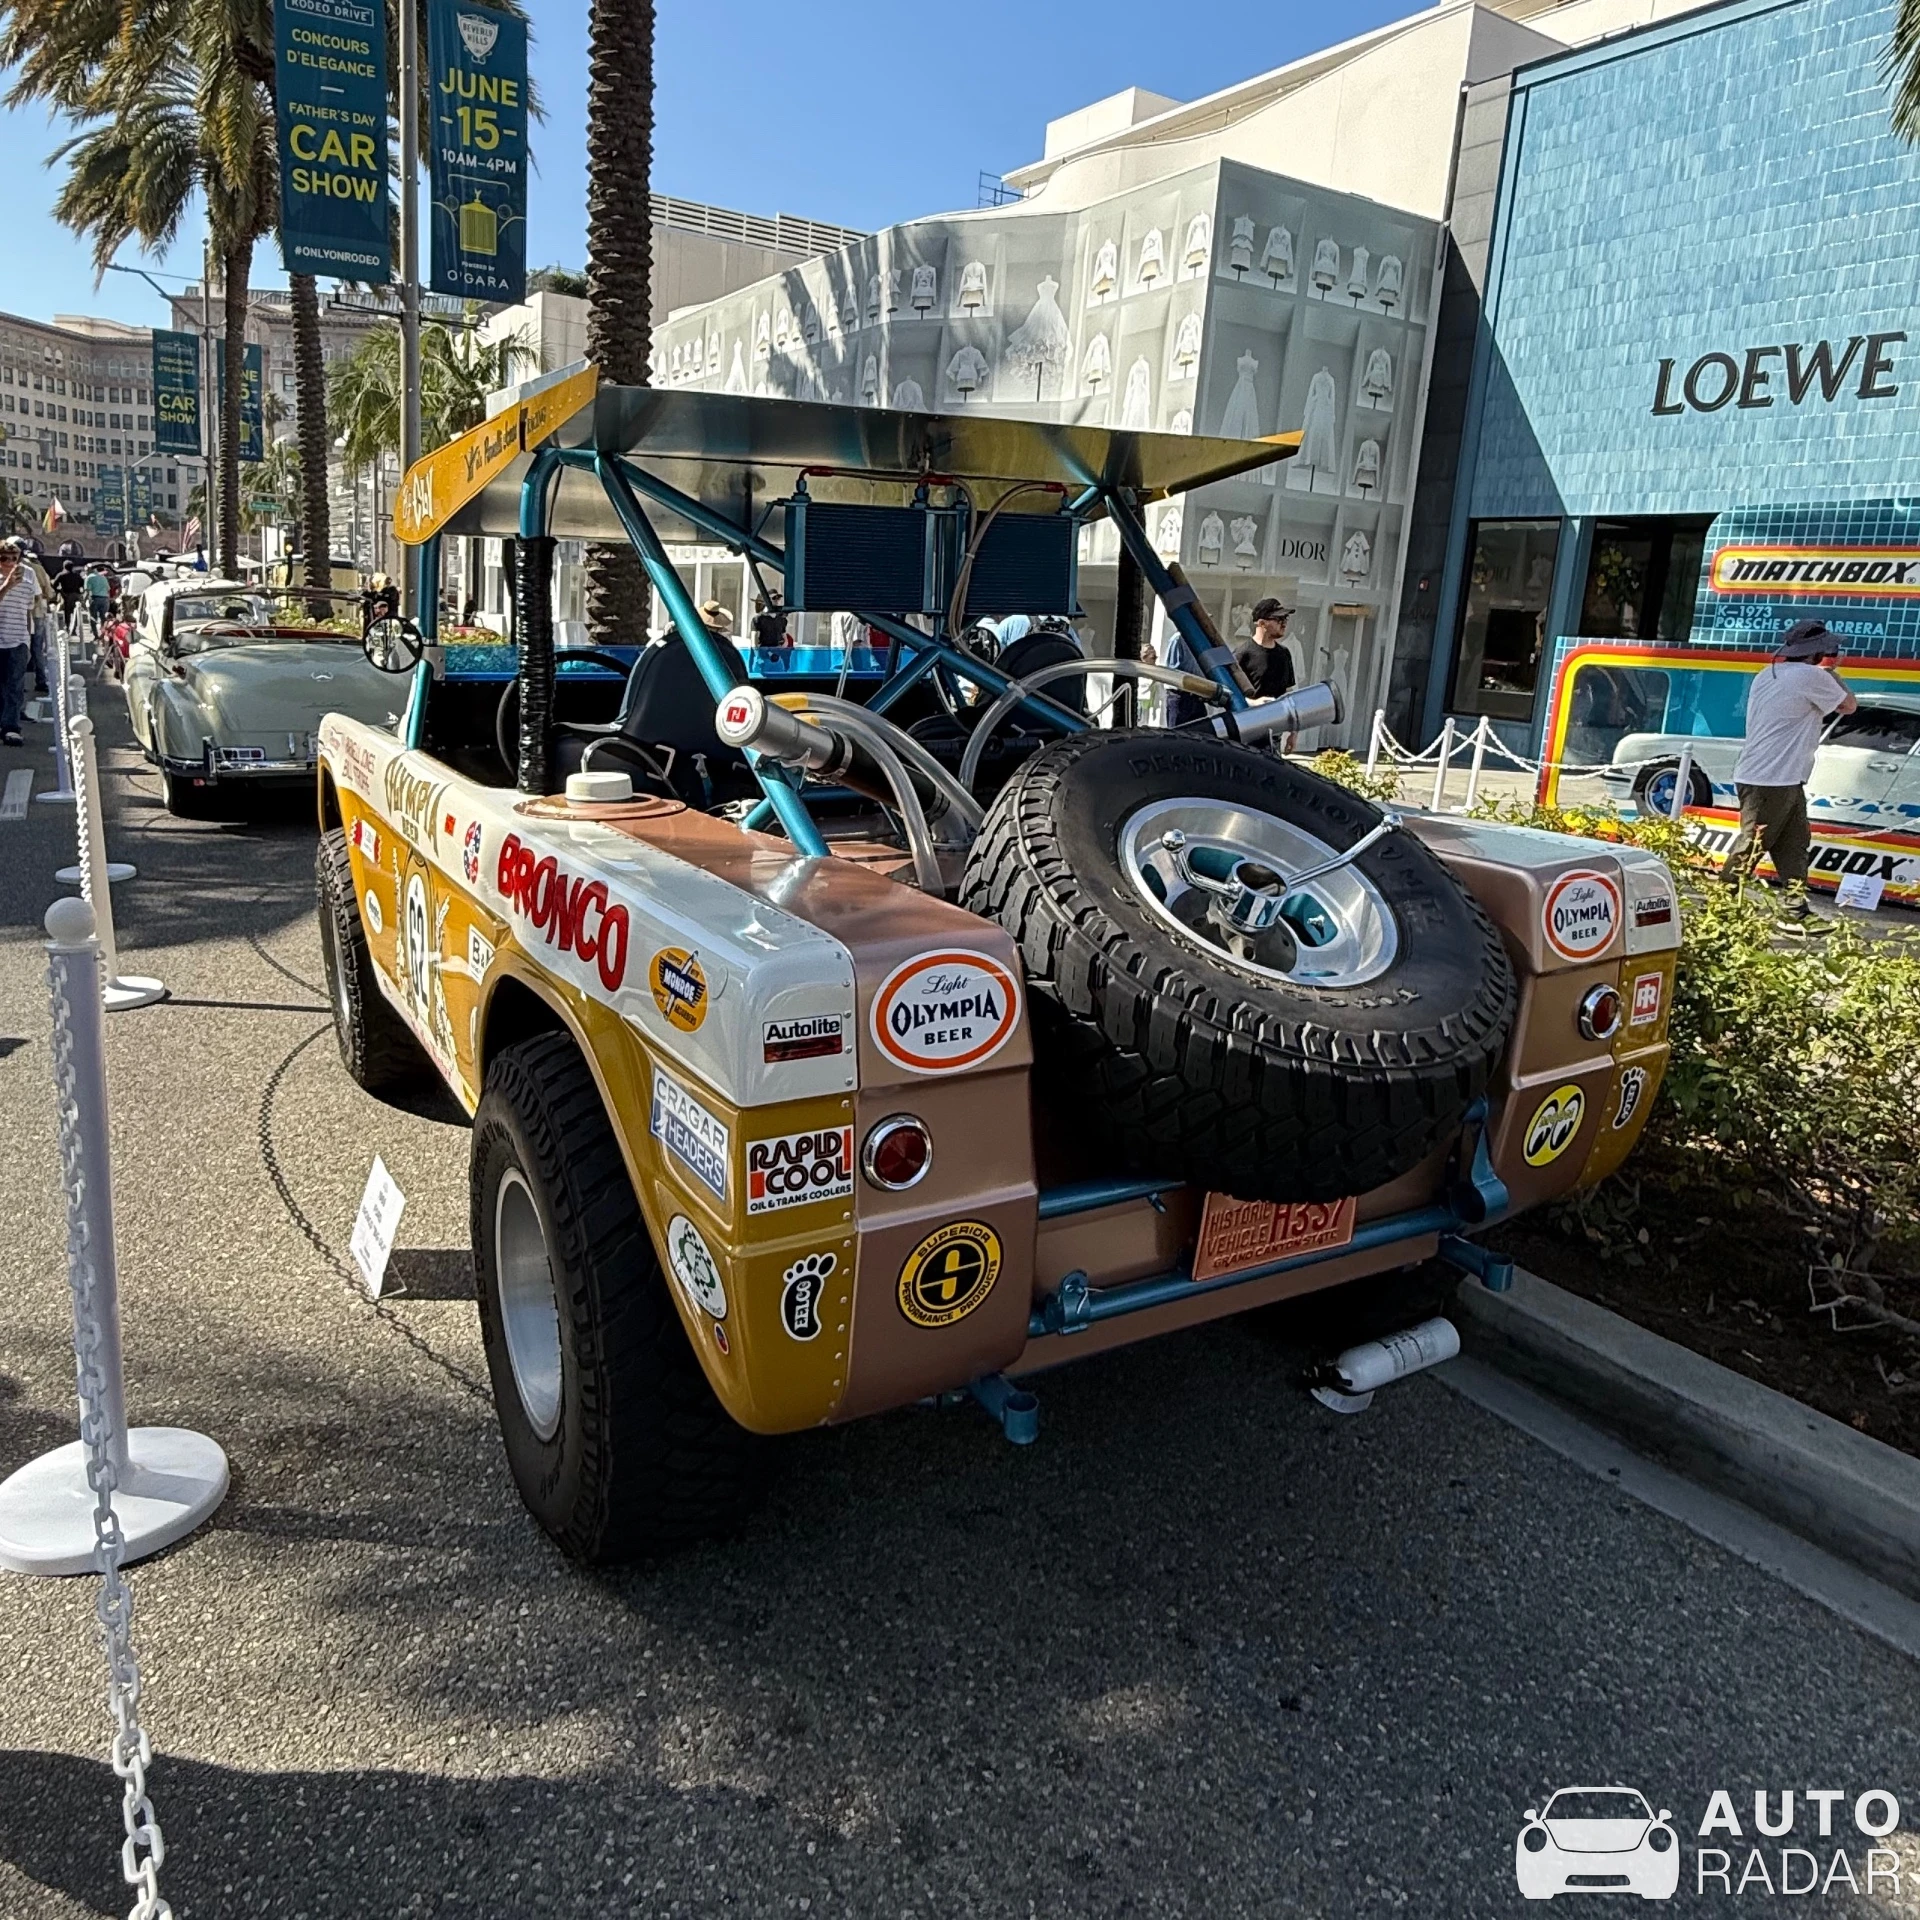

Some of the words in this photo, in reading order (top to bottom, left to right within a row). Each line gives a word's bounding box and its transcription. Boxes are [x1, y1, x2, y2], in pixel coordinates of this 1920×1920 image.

[334, 6, 368, 21] DRIVE
[291, 28, 370, 55] CONCOURS
[463, 23, 493, 37] BEVERLY
[467, 34, 488, 46] HILLS
[287, 49, 376, 78] D'ELEGANCE
[439, 68, 518, 107] JUNE
[289, 102, 350, 123] FATHER'S
[353, 113, 376, 128] DAY
[289, 125, 377, 171] CAR
[292, 168, 378, 203] SHOW
[295, 246, 380, 266] #ONLYONRODEO
[447, 269, 510, 290] O'GARA
[1650, 331, 1908, 416] LOEWE
[158, 393, 196, 412] CAR
[159, 410, 196, 425] SHOW
[1281, 539, 1326, 562] DIOR
[1729, 558, 1920, 584] MATCHBOX
[1717, 604, 1773, 618] K-1973
[1714, 616, 1781, 630] PORSCHE
[1824, 619, 1885, 636] ARRERA
[384, 753, 453, 859] OLYMPIA
[1568, 887, 1596, 903] Light
[1636, 898, 1671, 913] Autolite
[497, 832, 630, 993] BRONCO
[1553, 897, 1612, 933] OLYMPIA
[1571, 926, 1598, 941] BEER
[663, 967, 696, 1003] MONROE
[921, 974, 970, 995] Light
[890, 988, 1001, 1037] OLYMPIA
[765, 1017, 841, 1041] Autolite
[924, 1027, 973, 1046] BEER
[656, 1077, 725, 1155] CRAGAR
[667, 1115, 724, 1188] HEADERS
[750, 1130, 843, 1172] RAPID
[766, 1157, 852, 1195] COOL
[750, 1202, 767, 1212] OIL
[768, 1199, 776, 1208] &
[776, 1193, 808, 1207] TRANS
[809, 1184, 852, 1199] COOLERS
[1209, 1201, 1272, 1233] HISTORIC
[917, 1225, 991, 1258] SUPERIOR
[1207, 1223, 1269, 1257] VEHICLE
[1213, 1250, 1252, 1268] GRAND
[1255, 1237, 1301, 1258] CANYON
[1302, 1228, 1338, 1245] STATE
[902, 1281, 954, 1323] PERFORMANCE
[960, 1259, 998, 1314] PRODUCTS
[794, 1280, 812, 1331] EELCO
